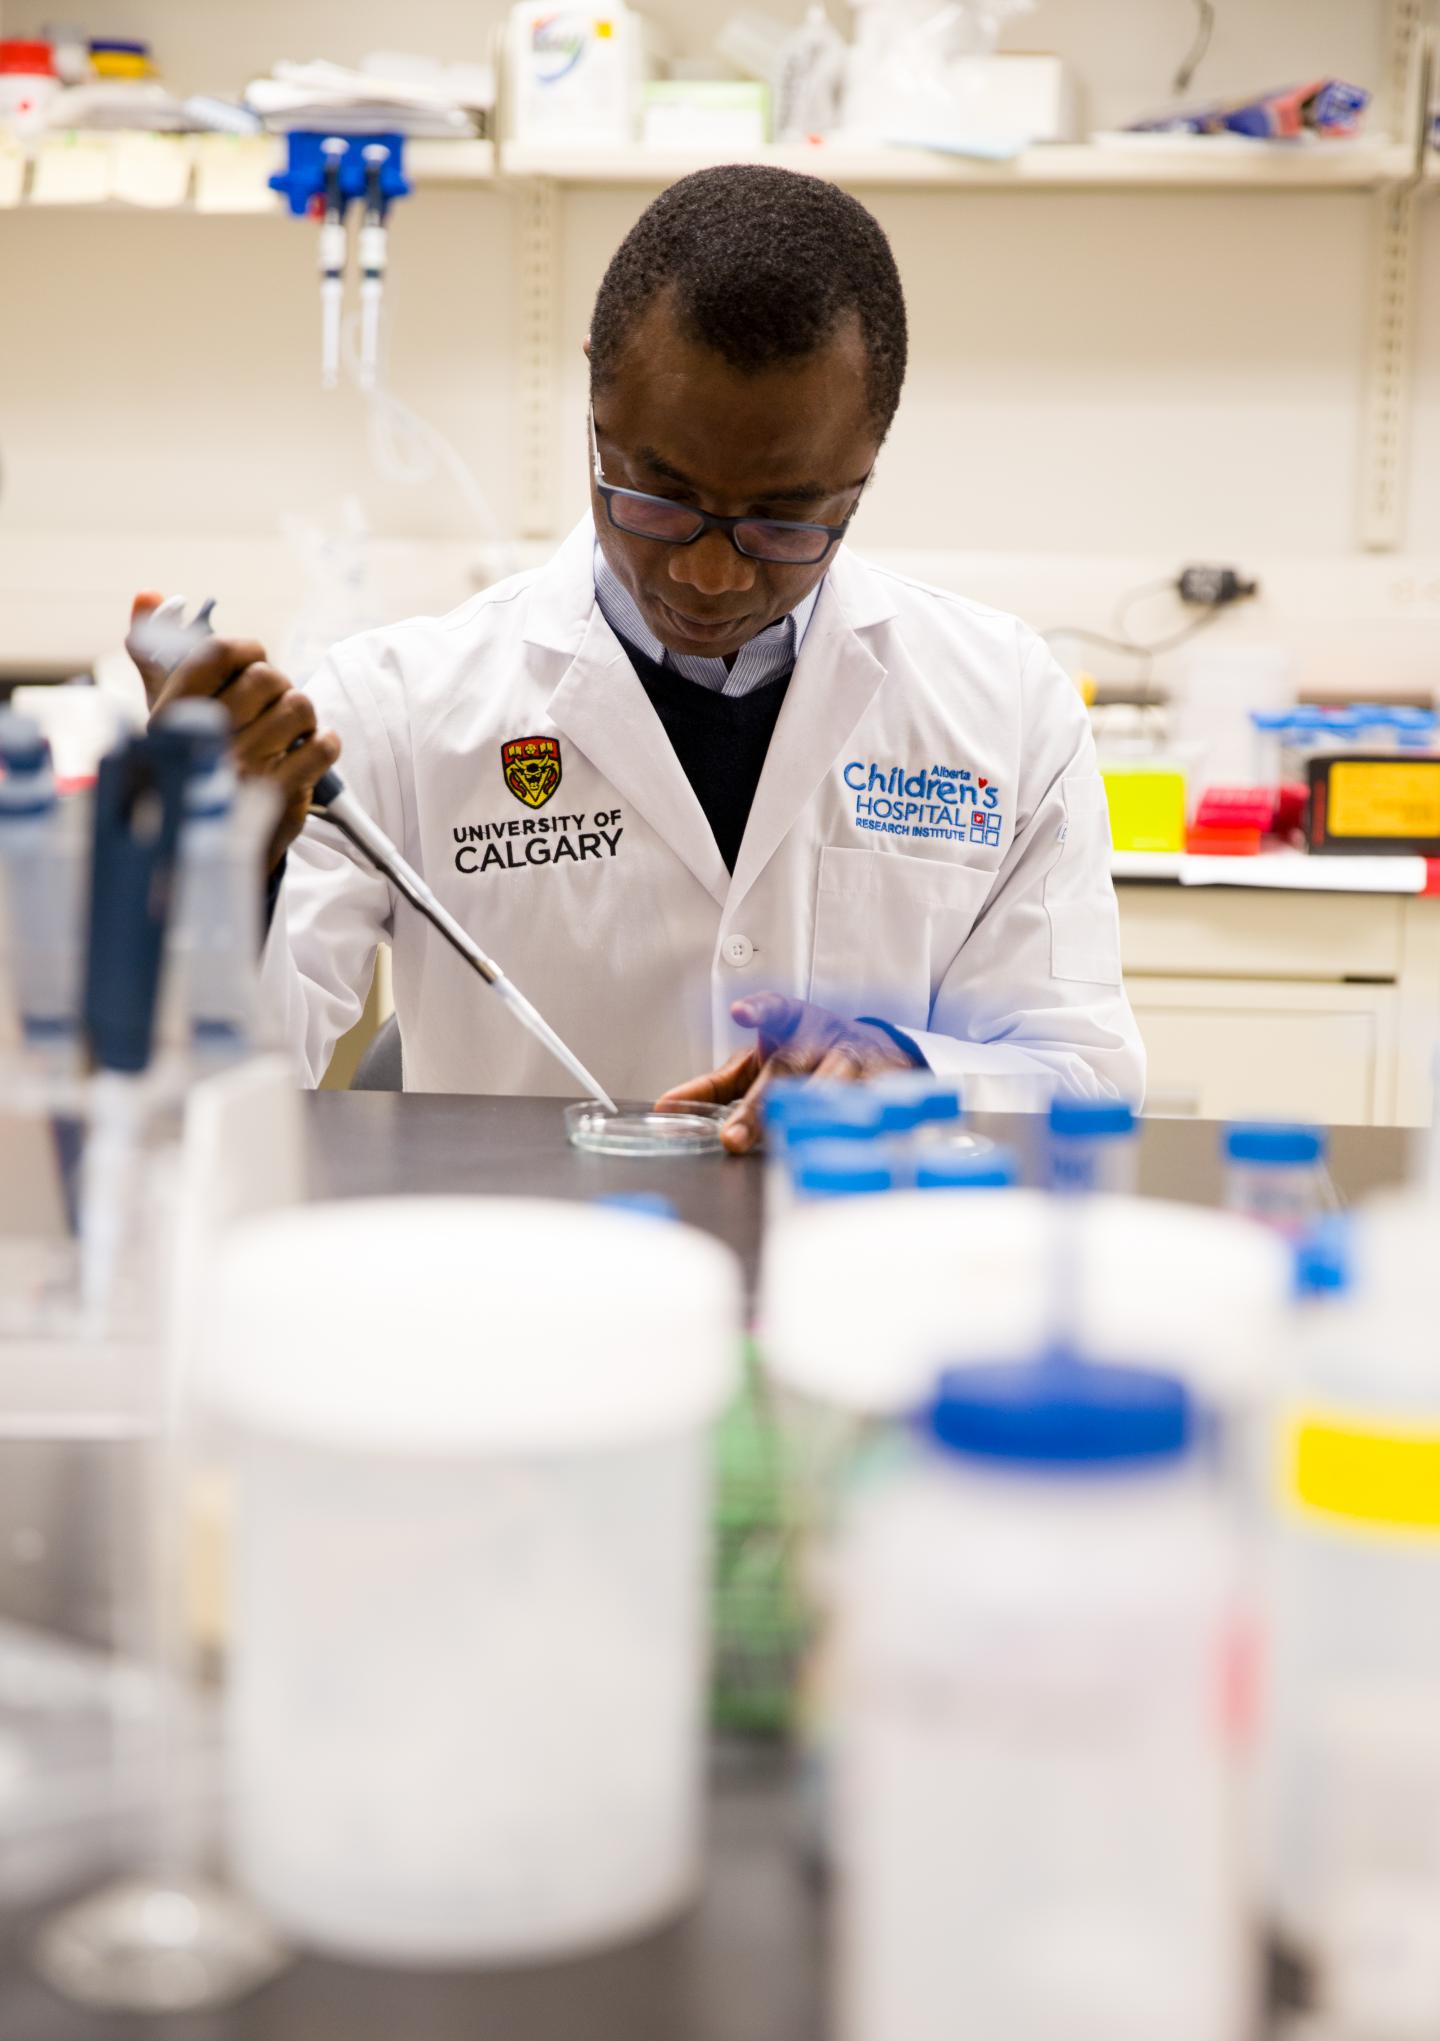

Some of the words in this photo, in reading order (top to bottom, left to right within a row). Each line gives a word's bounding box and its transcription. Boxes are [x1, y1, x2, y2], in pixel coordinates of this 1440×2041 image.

[931, 765, 971, 781] Alberta
[453, 814, 585, 843] UNIVERSITY
[593, 809, 622, 828] OF
[856, 795, 967, 828] HOSPITAL
[855, 817, 909, 836] RESEARCH
[911, 826, 965, 842] INSTITUTE
[455, 827, 624, 874] CALGARY
